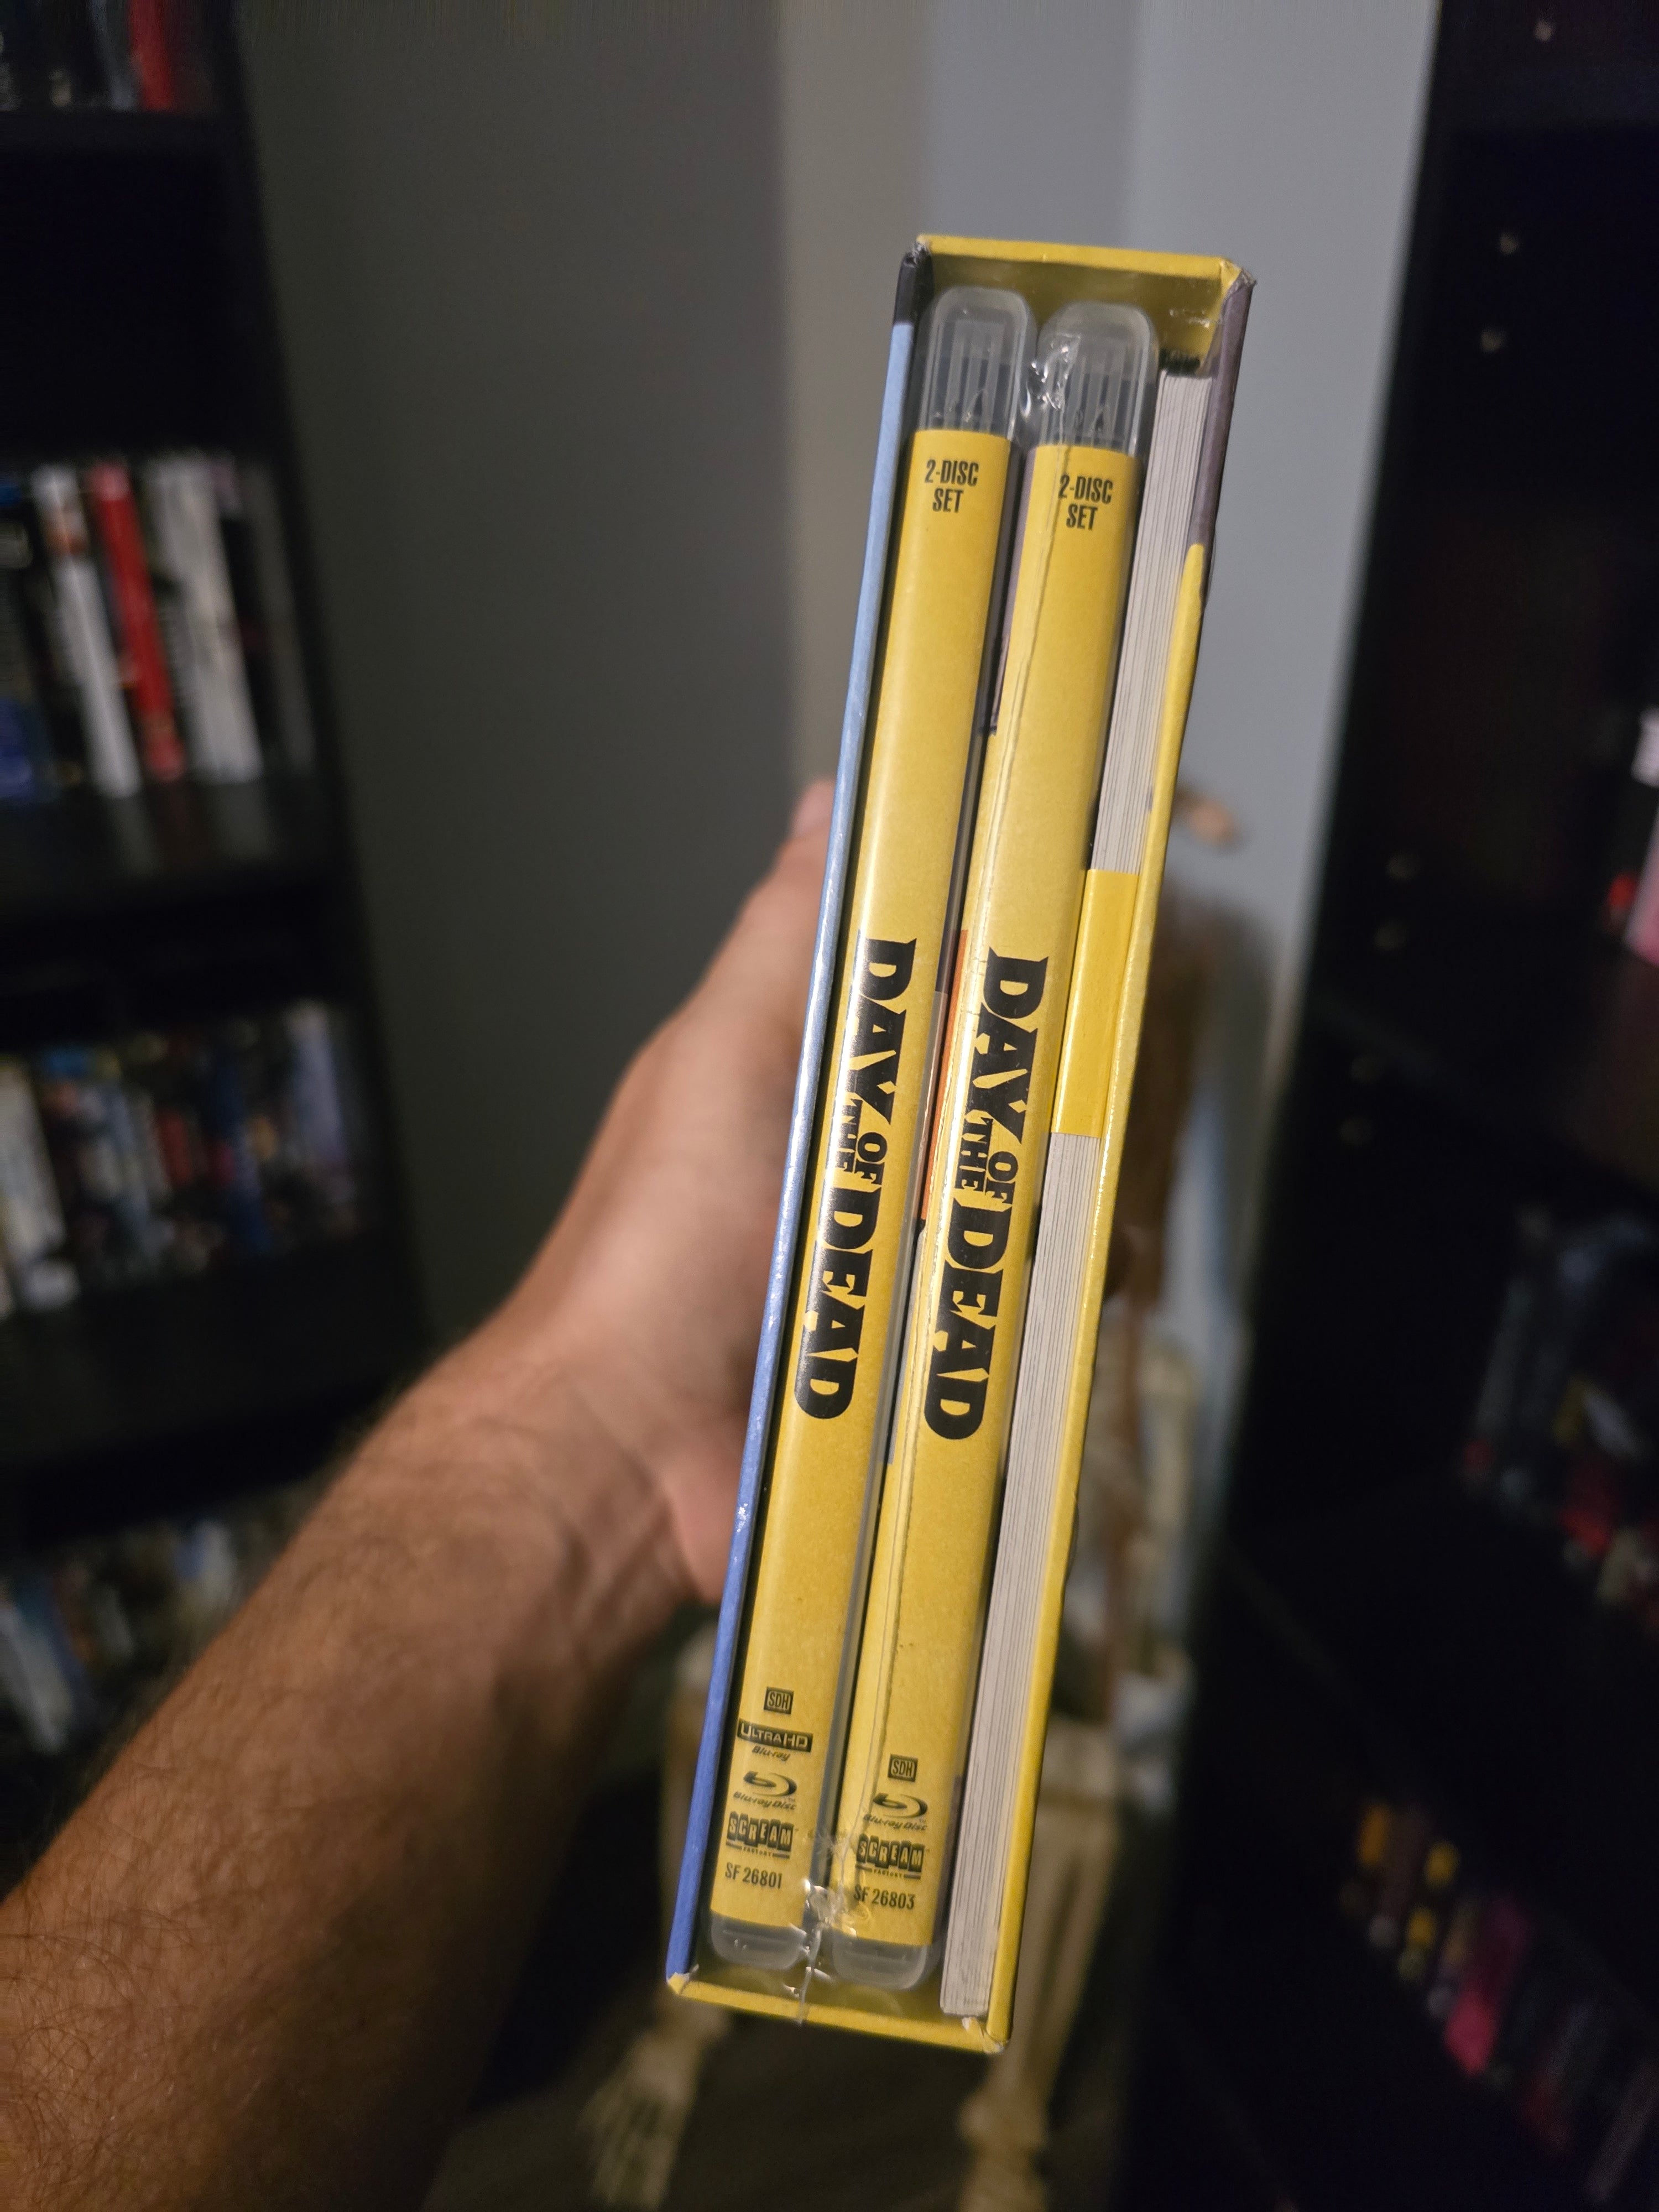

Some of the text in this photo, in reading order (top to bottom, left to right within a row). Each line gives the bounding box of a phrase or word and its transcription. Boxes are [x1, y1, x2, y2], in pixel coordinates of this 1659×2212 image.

[924, 458, 979, 487] 2-DISC
[932, 488, 964, 513] SET
[1058, 474, 1113, 504] 2-DISC
[1066, 504, 1098, 530] SET
[794, 930, 917, 1420] DAY OF THE DEAD
[924, 946, 1049, 1440] DAY OF THE DEAD
[768, 1689, 791, 1710] SDH
[752, 1745, 791, 1762] Blu-ray
[891, 1758, 915, 1777] SDH
[733, 1791, 797, 1811] Blu-ray Disc
[728, 1814, 792, 1851] SCREAM
[904, 1820, 928, 1832] Disc
[858, 1837, 923, 1871] SCREAM
[725, 1861, 782, 1889] SF 26801
[853, 1884, 915, 1910] SF 26803
